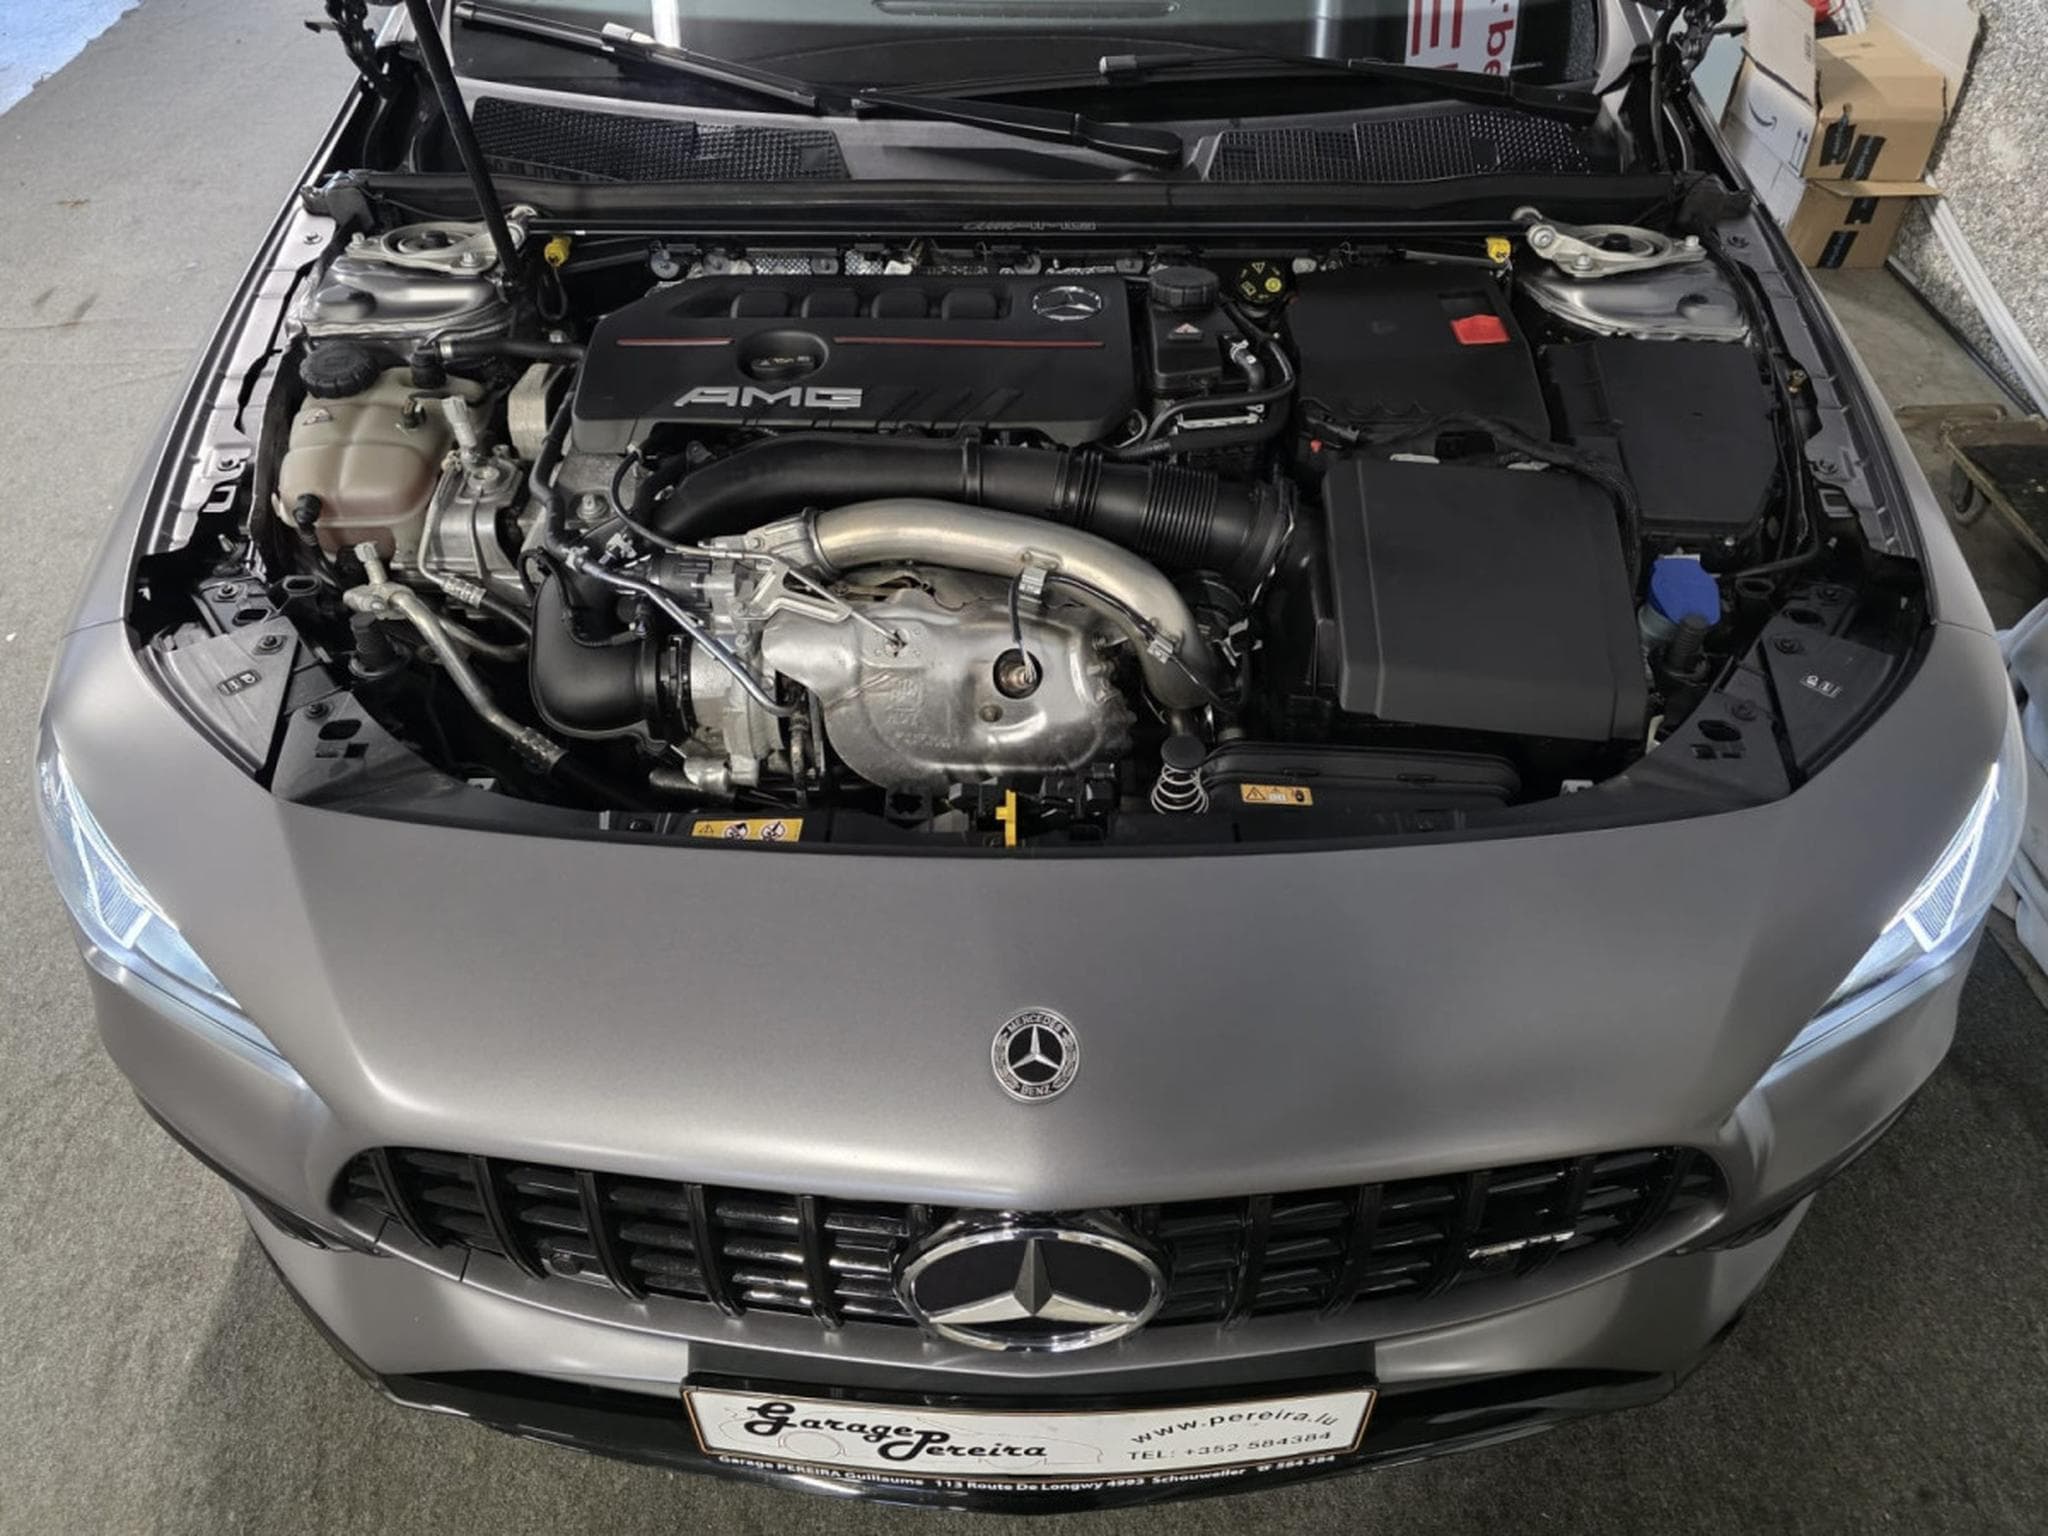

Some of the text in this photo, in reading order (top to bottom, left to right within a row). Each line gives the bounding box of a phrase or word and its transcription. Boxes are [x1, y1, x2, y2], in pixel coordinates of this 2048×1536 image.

[673, 386, 863, 409] AMG
[1007, 1013, 1064, 1033] MERCEDES
[1020, 1083, 1053, 1097] BENZ
[743, 1401, 1049, 1461] Garage Pereira
[1131, 1408, 1338, 1444] www.pereira.lu
[1128, 1431, 1332, 1461] TEL: +352 584384
[718, 1455, 775, 1471] Garage
[777, 1463, 842, 1479] PEREIRA
[935, 1480, 963, 1489] 113
[967, 1480, 1013, 1491] Route
[1016, 1482, 1038, 1491] De
[1041, 1481, 1104, 1491] Longwy
